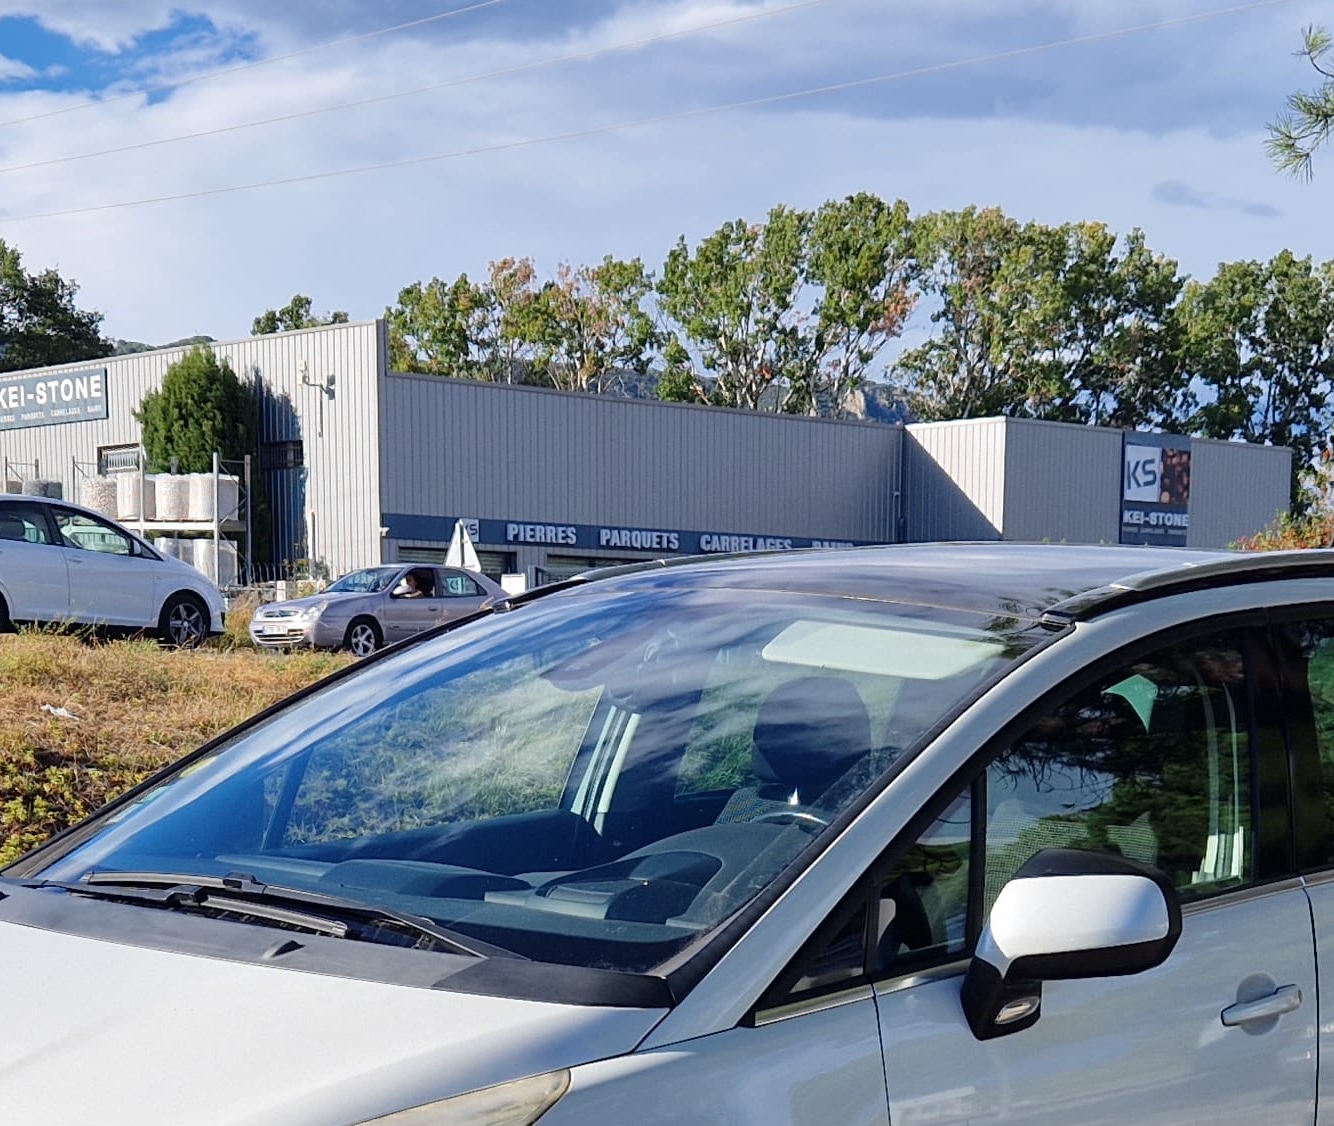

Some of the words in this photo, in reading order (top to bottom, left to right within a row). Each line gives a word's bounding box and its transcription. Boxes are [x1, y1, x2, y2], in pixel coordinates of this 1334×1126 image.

[1127, 459, 1157, 490] KS
[1122, 509, 1189, 527] KEI-STONE
[506, 523, 577, 545] PIERRES
[600, 528, 680, 550] PARQUETS
[700, 534, 793, 551] CARRELAGES
